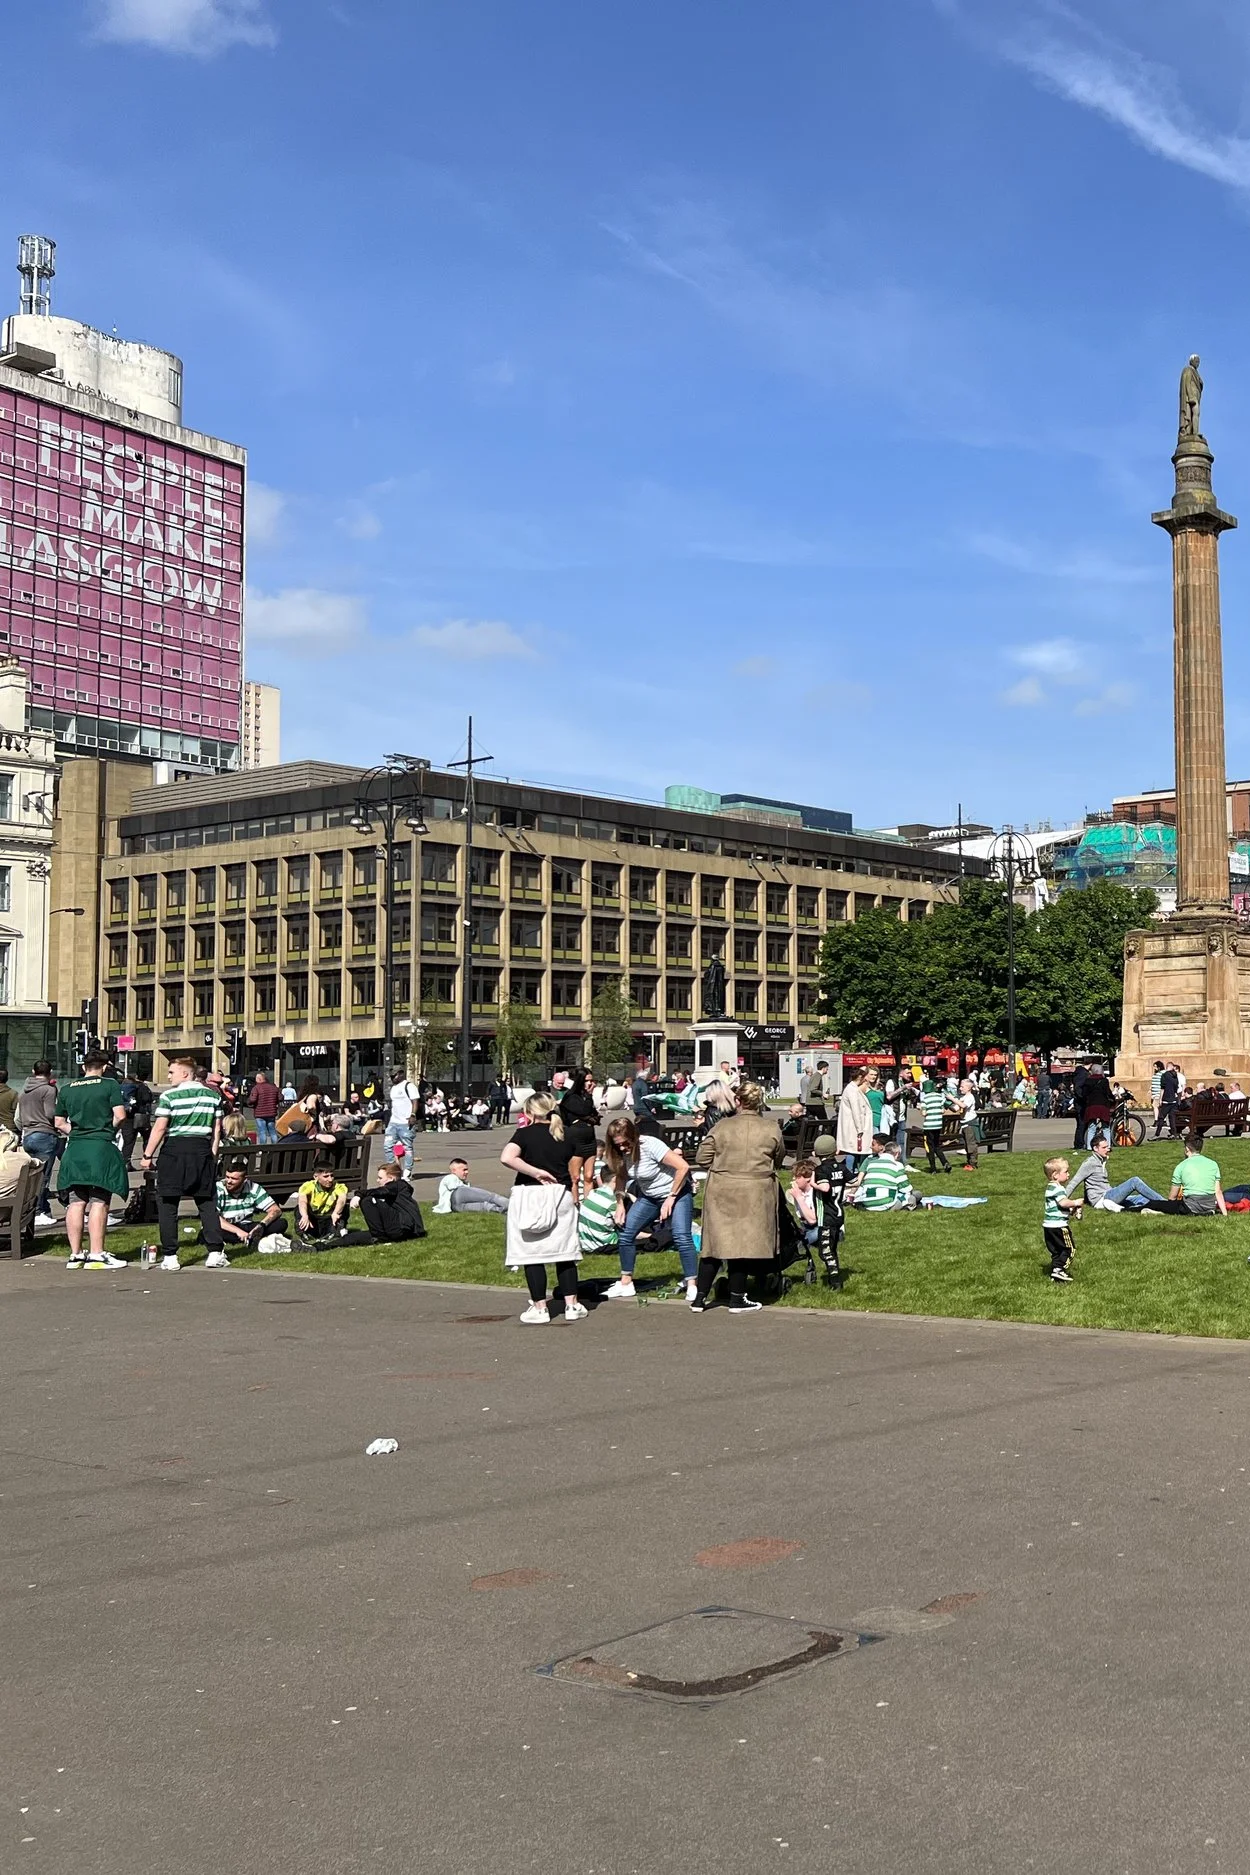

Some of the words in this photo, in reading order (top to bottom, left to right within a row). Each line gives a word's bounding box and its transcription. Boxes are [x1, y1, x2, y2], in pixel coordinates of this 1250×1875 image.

[40, 419, 228, 520] PEOPLE
[82, 488, 227, 567] MAKE
[300, 1046, 326, 1056] COSTA
